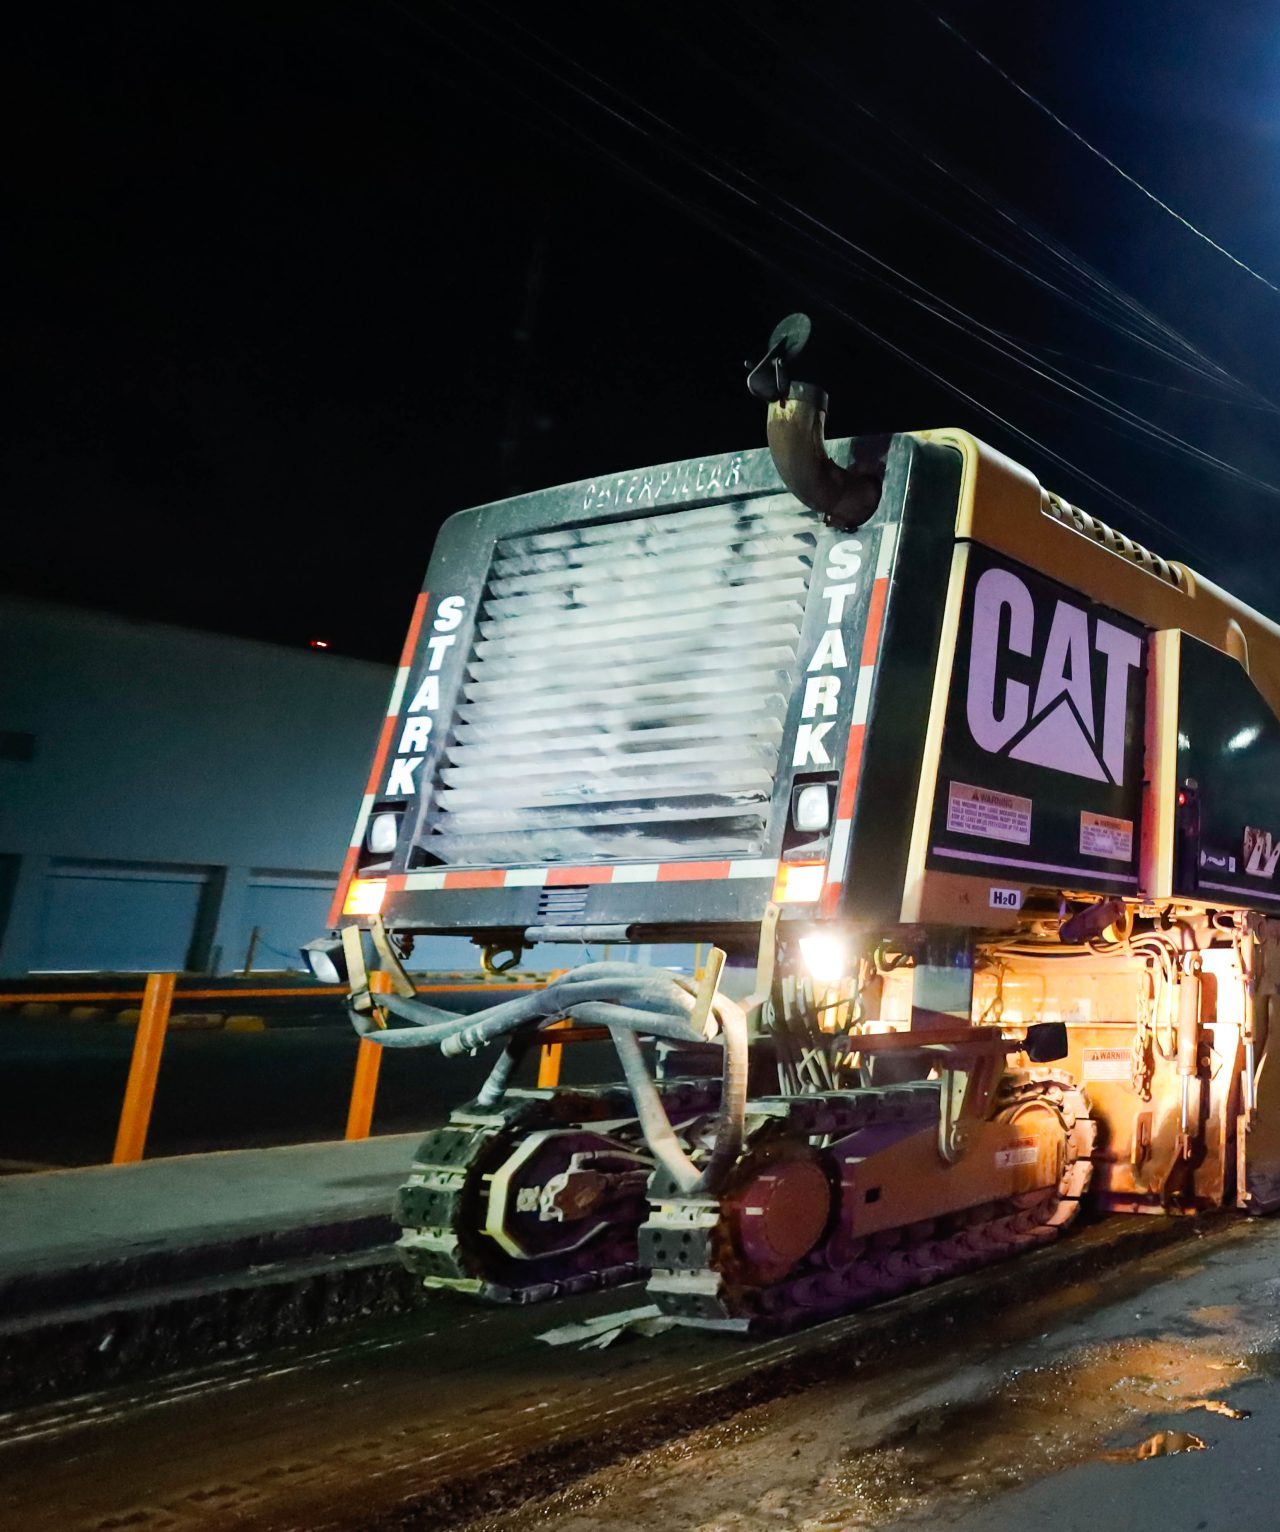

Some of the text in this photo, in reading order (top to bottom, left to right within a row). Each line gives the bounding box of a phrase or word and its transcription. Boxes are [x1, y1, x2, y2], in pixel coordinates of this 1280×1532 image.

[583, 456, 743, 510] CATERPILLAR
[385, 595, 466, 796] STARK
[792, 539, 863, 767] STARK
[966, 568, 1142, 787] CAT
